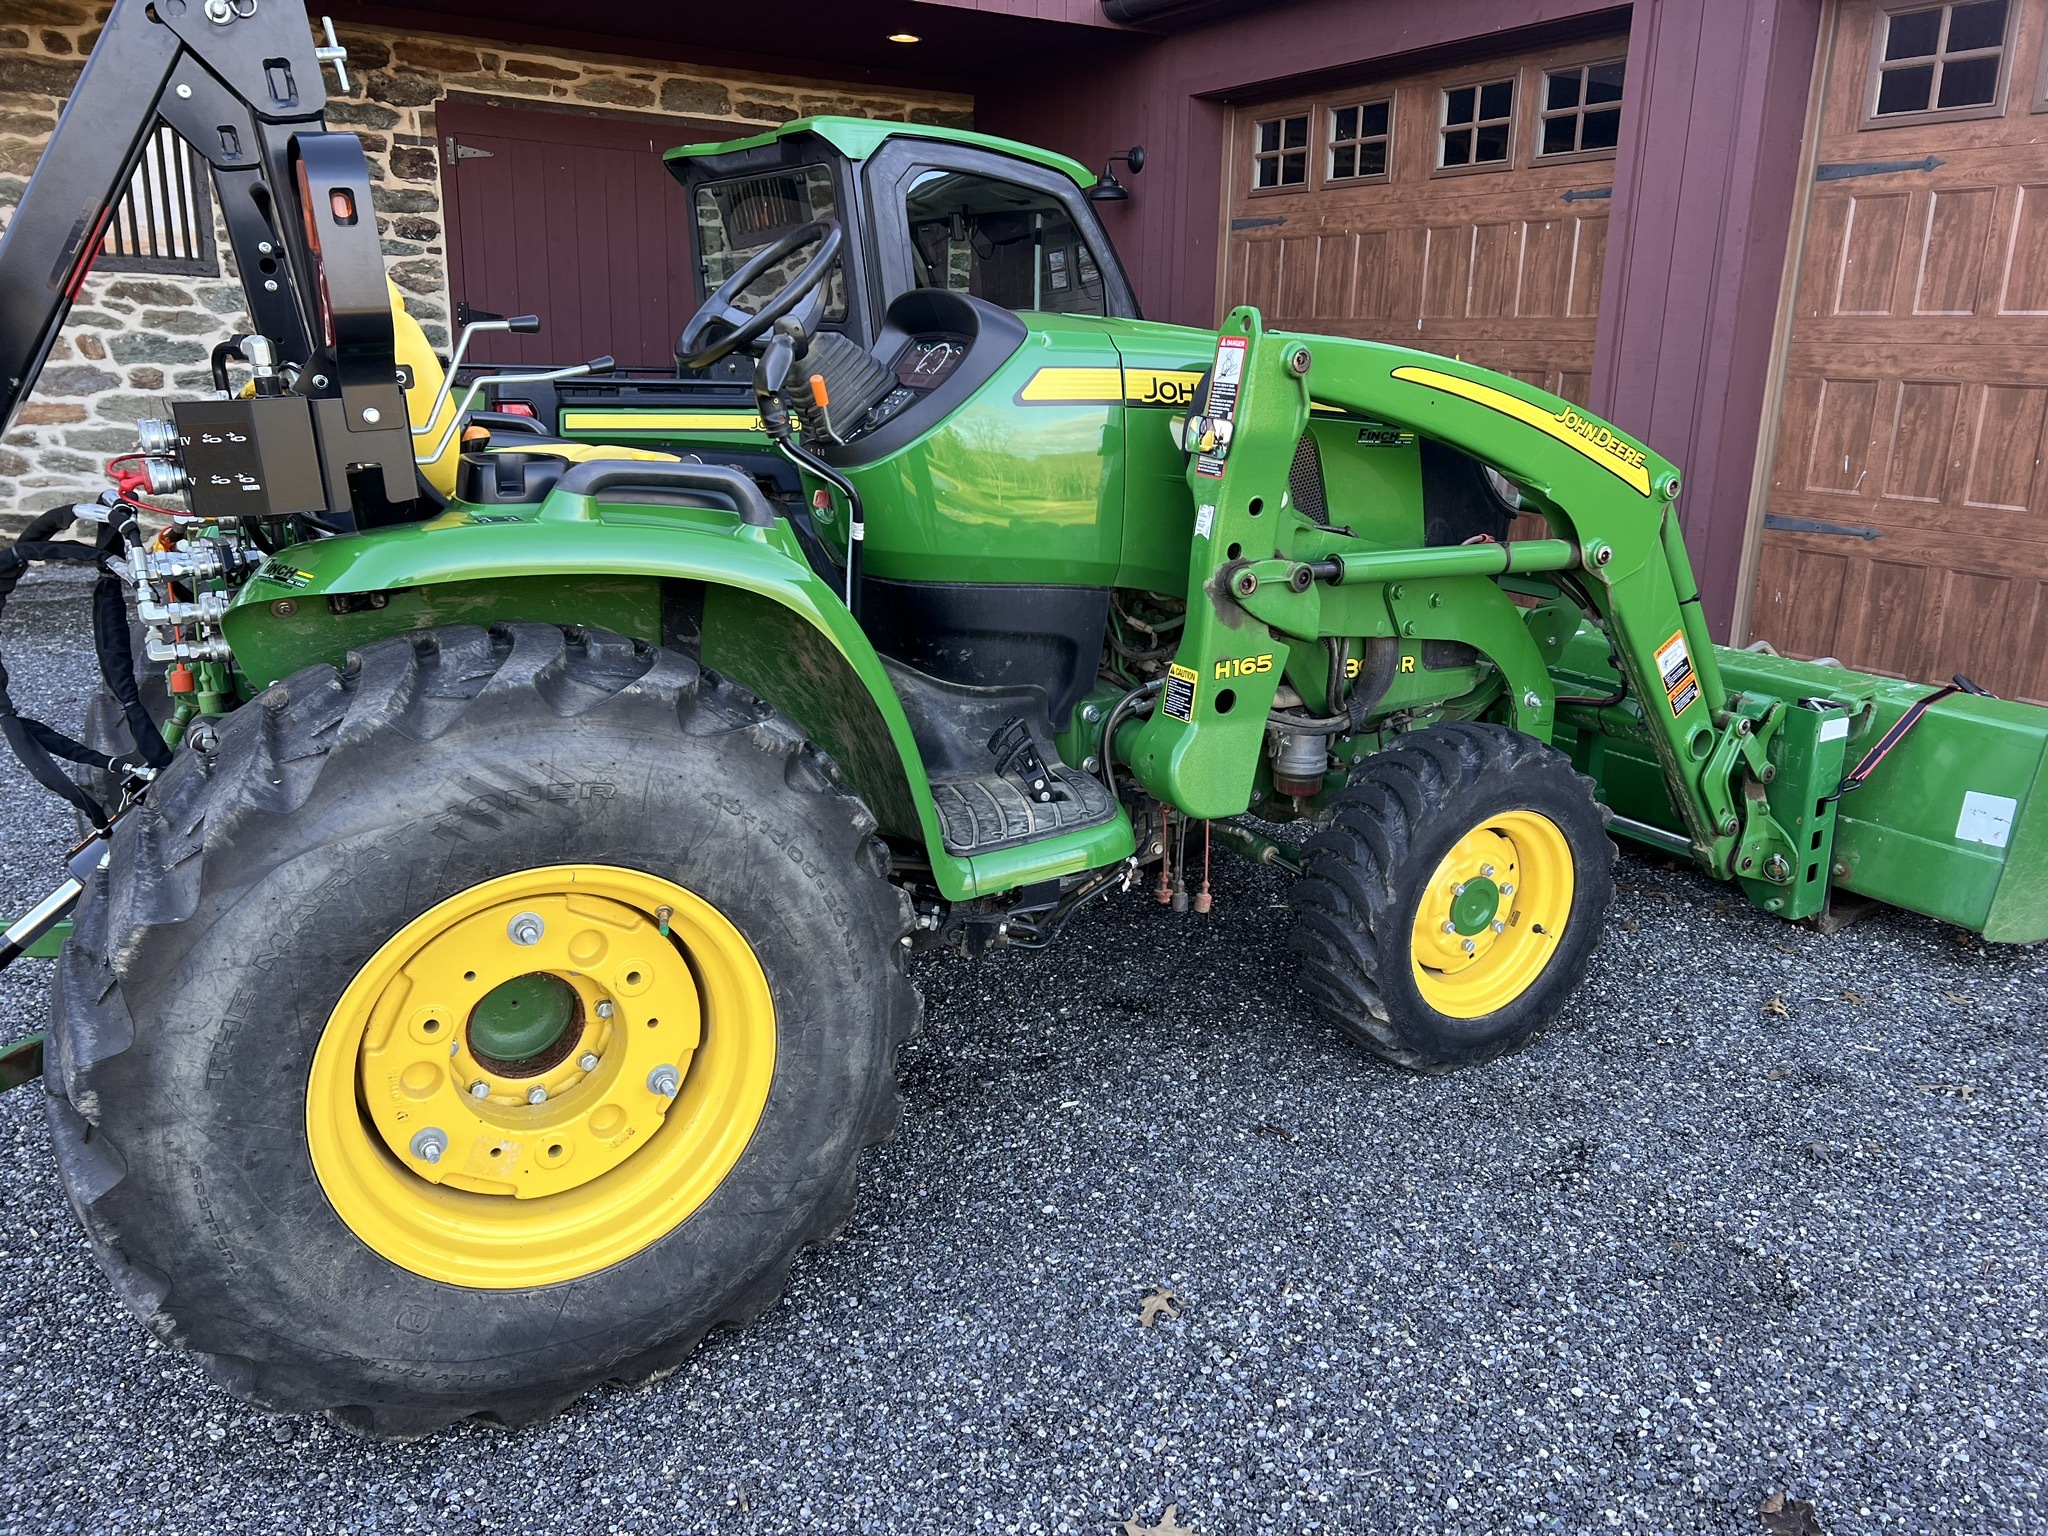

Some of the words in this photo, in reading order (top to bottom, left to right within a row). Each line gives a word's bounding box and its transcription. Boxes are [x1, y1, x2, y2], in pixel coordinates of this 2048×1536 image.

[1226, 339, 1246, 347] DANGER
[1143, 376, 1195, 401] JOH
[180, 436, 191, 446] IV
[1357, 427, 1401, 441] FINCH
[1555, 405, 1599, 441] JOHN
[1593, 426, 1647, 469] DEERE
[188, 476, 197, 486] V
[1214, 652, 1273, 681] H165
[1175, 667, 1196, 681] CAUTION
